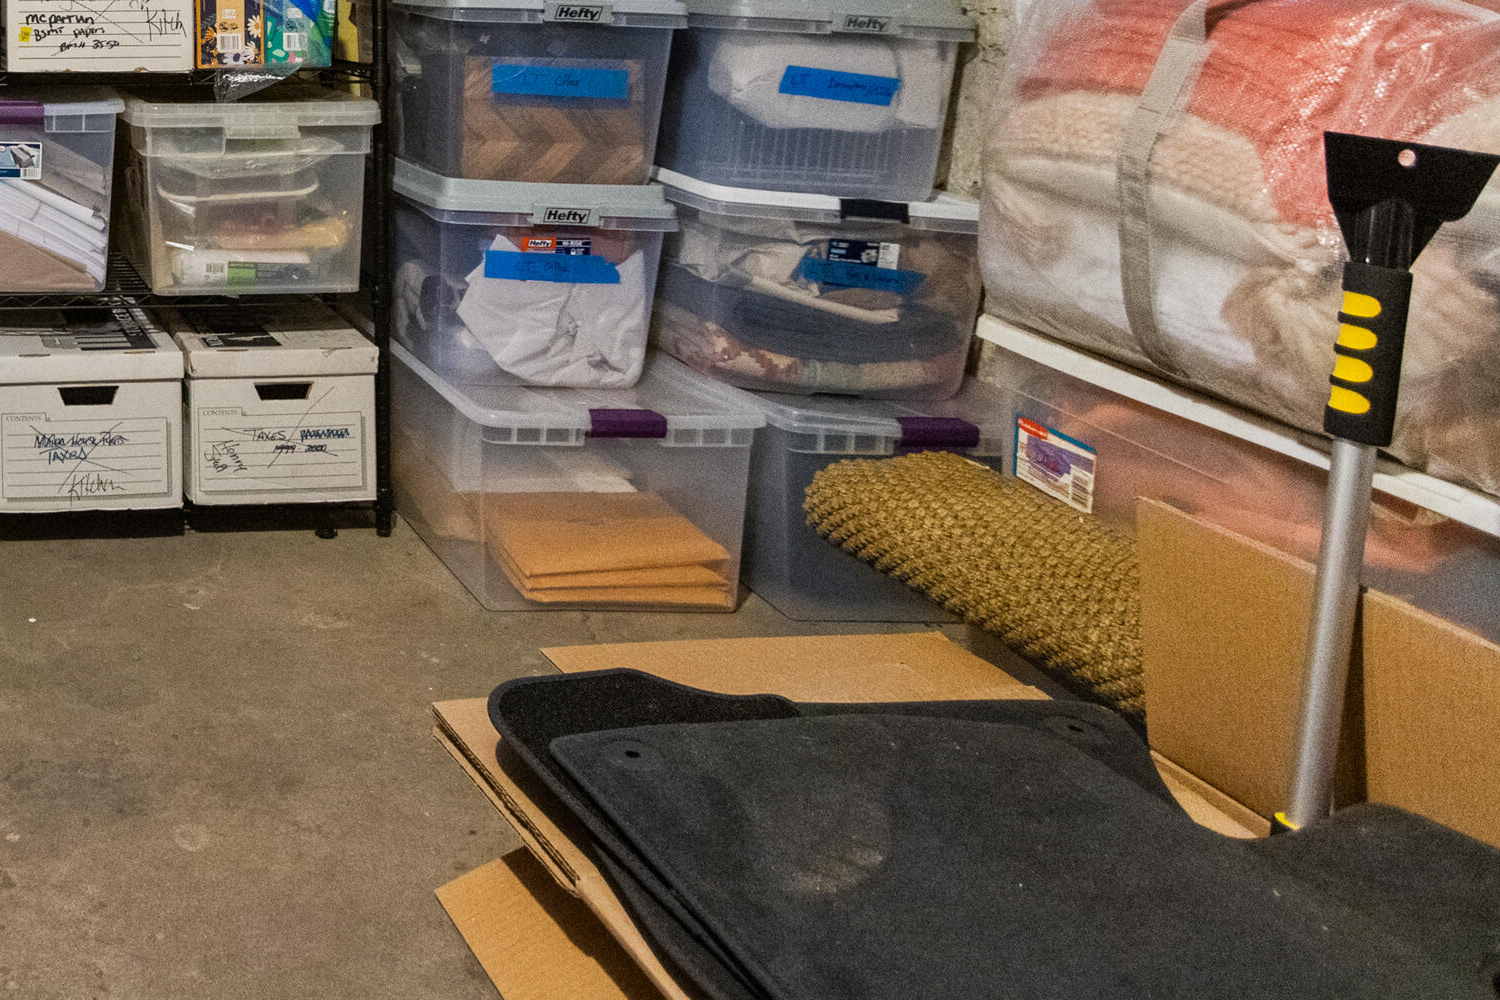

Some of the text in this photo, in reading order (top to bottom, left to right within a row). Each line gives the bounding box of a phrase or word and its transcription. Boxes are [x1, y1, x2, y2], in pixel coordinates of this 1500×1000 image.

[558, 6, 599, 20] Hefty
[847, 17, 887, 32] Hefty
[547, 210, 587, 223] Hefty
[529, 239, 552, 248] Hefty
[203, 409, 238, 417] CONTENTS
[244, 428, 288, 442] TAXES
